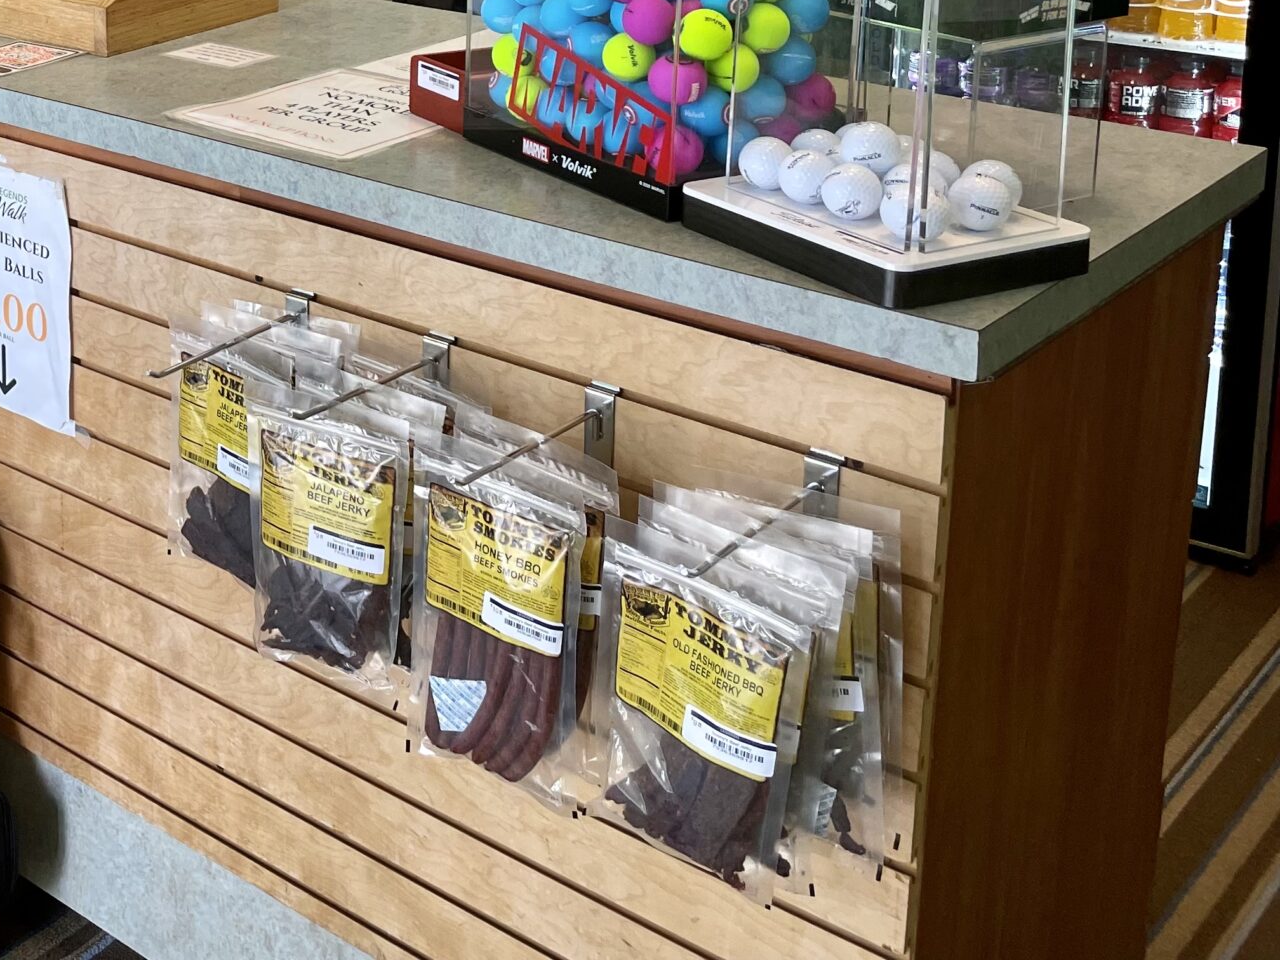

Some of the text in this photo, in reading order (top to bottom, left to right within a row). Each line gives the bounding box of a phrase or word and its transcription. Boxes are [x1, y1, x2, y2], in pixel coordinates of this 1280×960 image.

[627, 44, 639, 67] Volvik
[300, 105, 382, 127] PLAYERS
[319, 91, 410, 116] NO MORE
[323, 101, 380, 117] THAN
[258, 106, 373, 134] PER GROUP
[522, 137, 551, 165] MARVEL
[561, 155, 594, 180] Volvik
[3, 256, 44, 284] BALLS
[216, 409, 233, 424] BEEF
[307, 490, 371, 518] BEEF JERKY
[473, 522, 556, 562] SMOKIES
[474, 554, 539, 589] BEEF SMOKIES
[475, 540, 542, 577] HONEY BBQ
[683, 623, 763, 675] JERKY
[673, 638, 765, 698] OLD FASHIONED BBQ
[689, 661, 742, 699] BEEF JERKY
